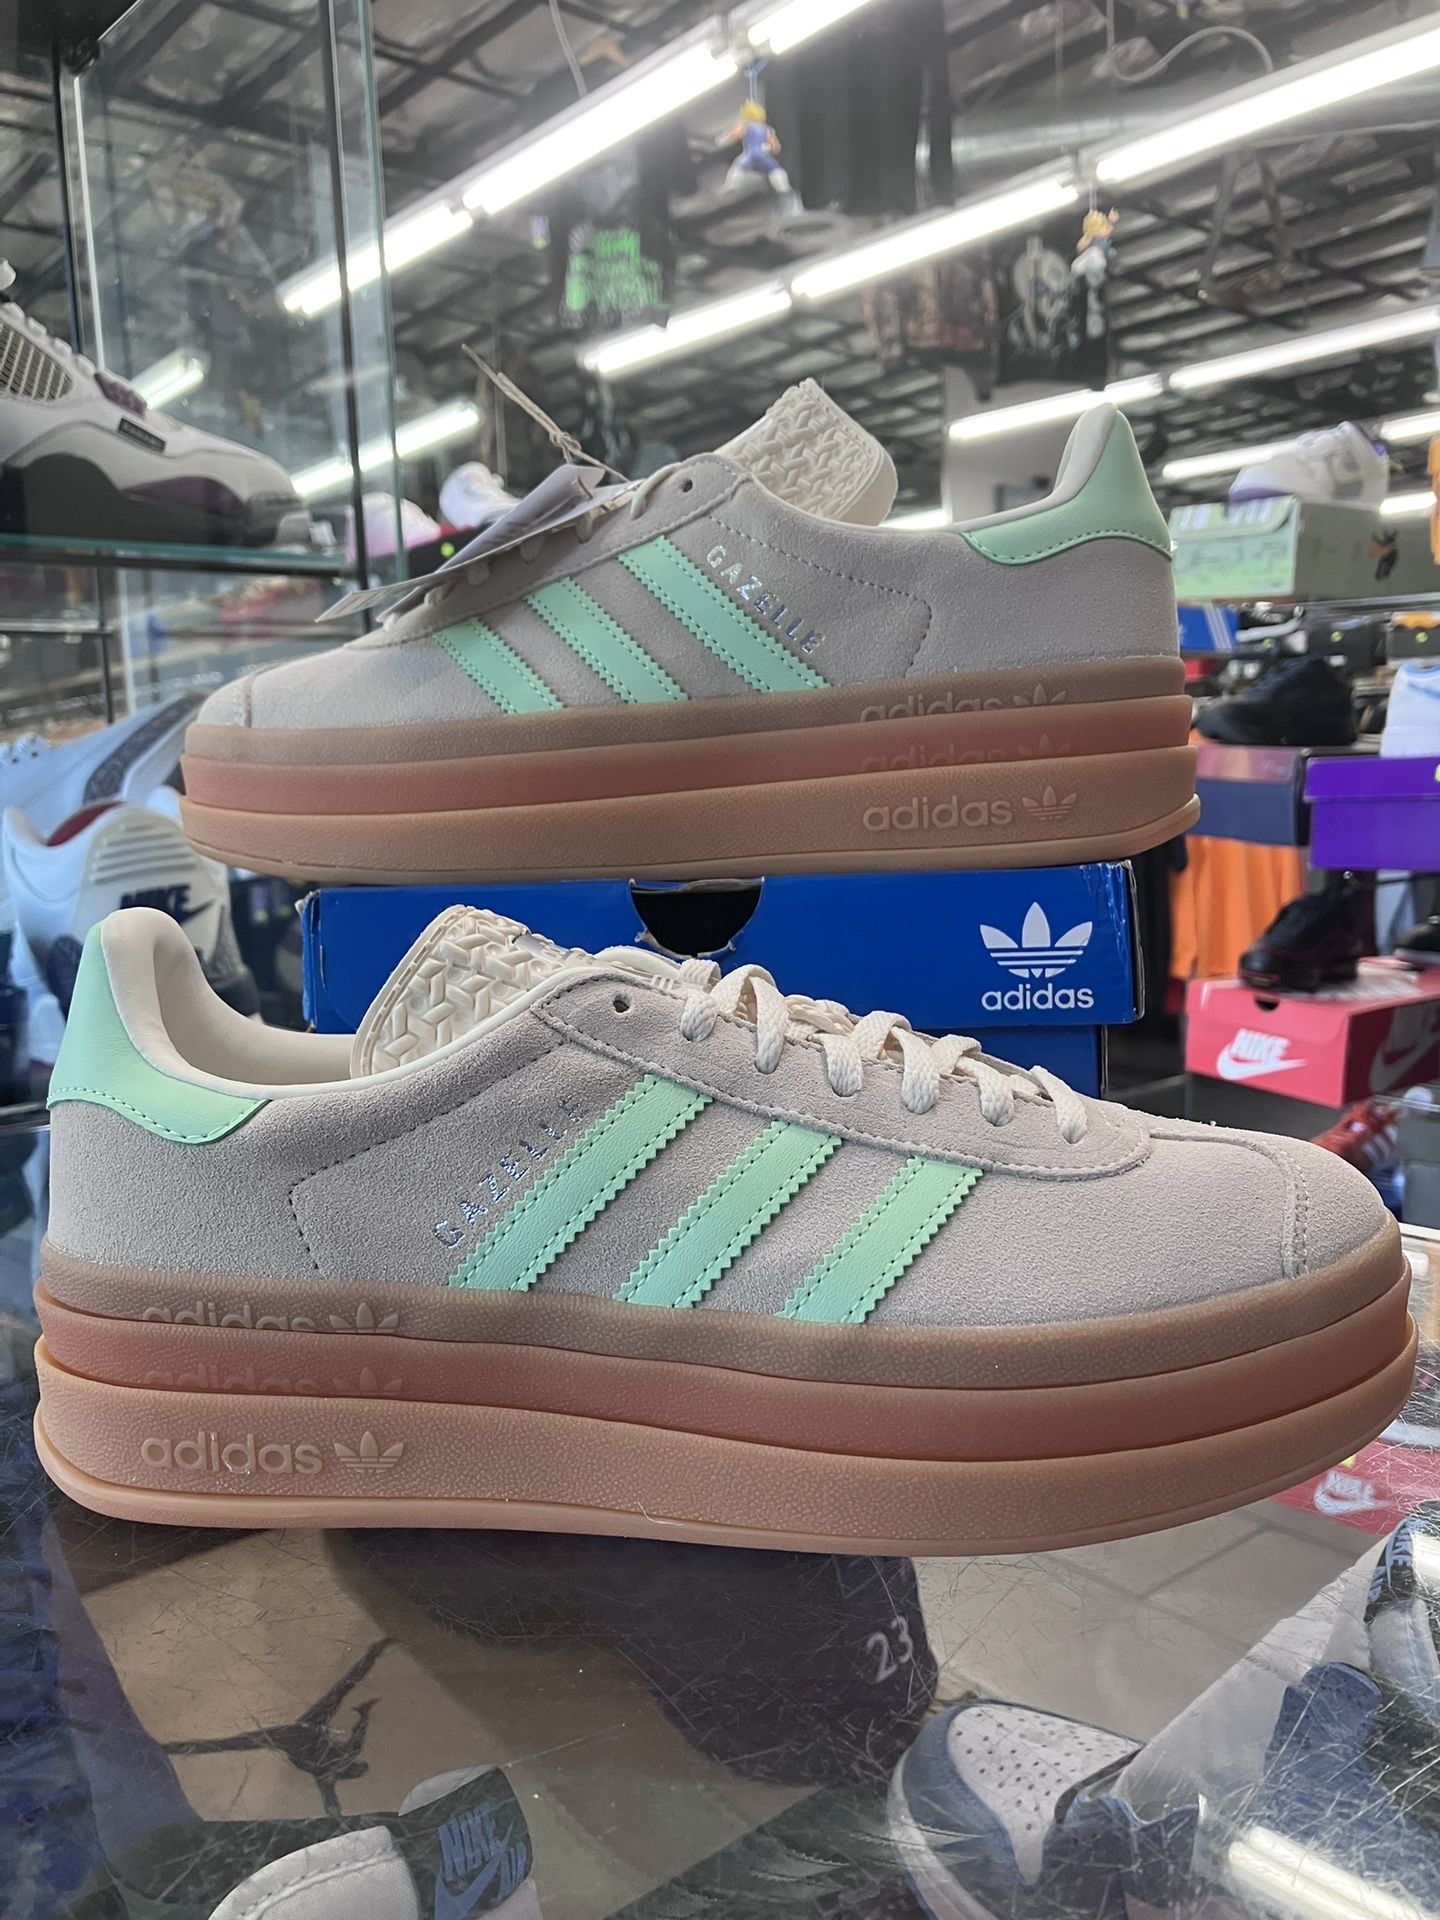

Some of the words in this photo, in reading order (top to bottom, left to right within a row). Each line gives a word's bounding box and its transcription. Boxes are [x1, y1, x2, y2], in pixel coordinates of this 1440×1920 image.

[706, 545, 825, 654] GAZELLE
[863, 795, 1013, 832] adidas
[981, 983, 1094, 1010] adidas
[434, 1096, 588, 1249] GAZELLE
[141, 1430, 323, 1474] adidas
[866, 1615, 913, 1683] 23
[438, 1801, 502, 1882] NIKE
[498, 1841, 527, 1902] AIR
